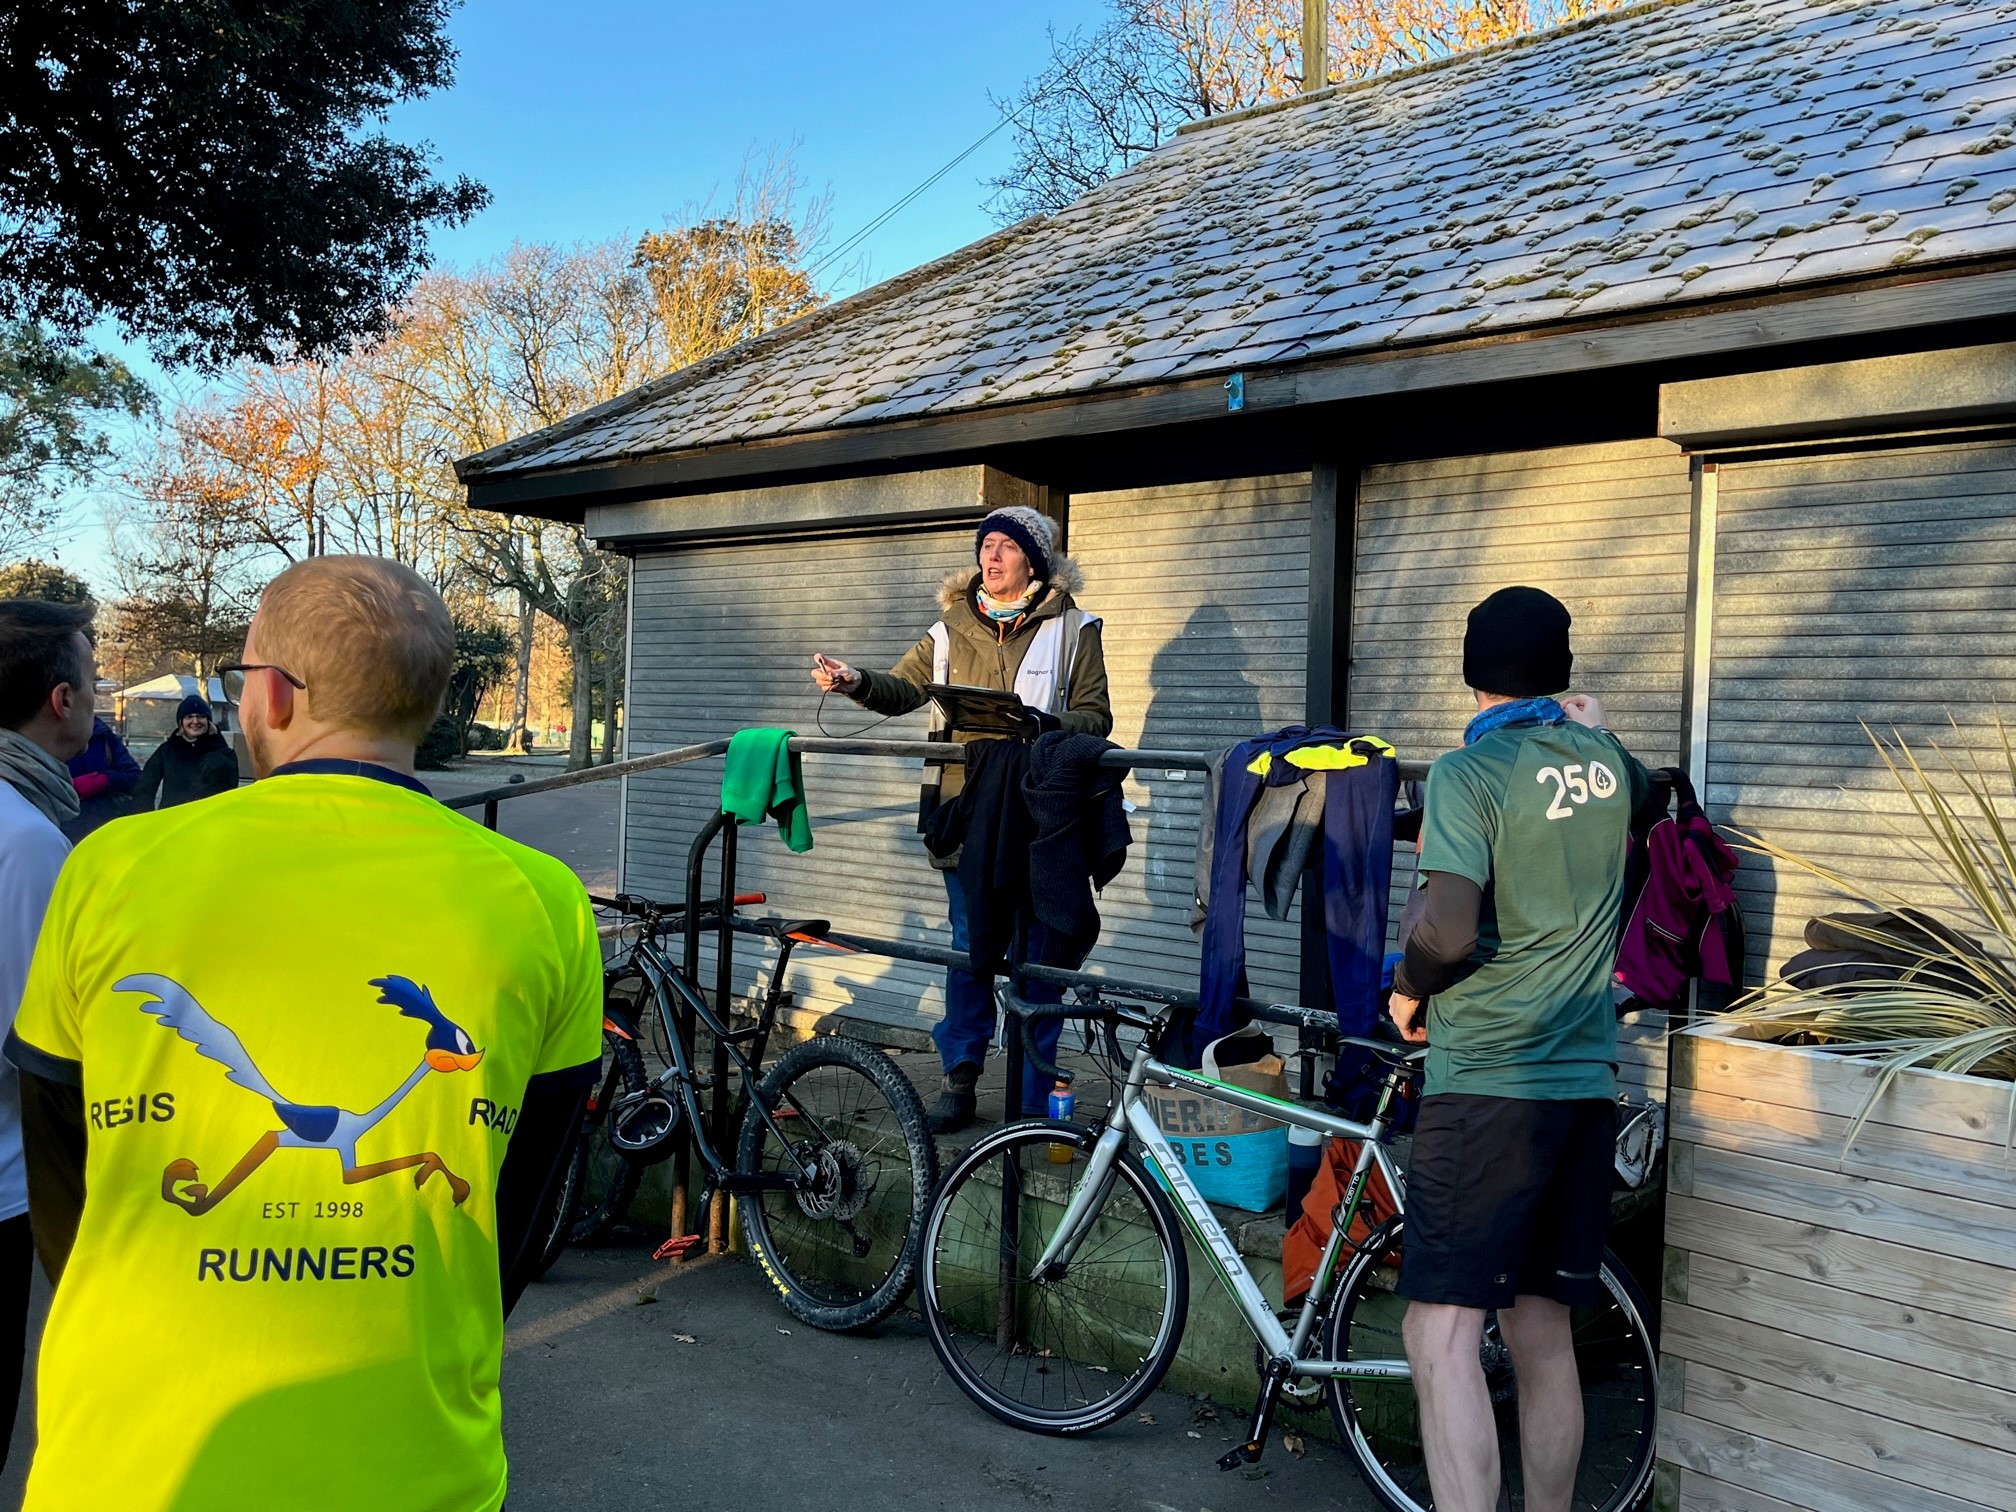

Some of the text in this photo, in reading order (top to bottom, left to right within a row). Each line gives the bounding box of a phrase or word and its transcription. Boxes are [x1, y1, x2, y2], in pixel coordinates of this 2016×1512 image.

[1536, 761, 1617, 820] 250
[91, 1092, 175, 1130] REGIS
[262, 1201, 364, 1219] EST 1998
[198, 1244, 415, 1282] RUNNERS
[752, 1243, 790, 1295] MAXXIS
